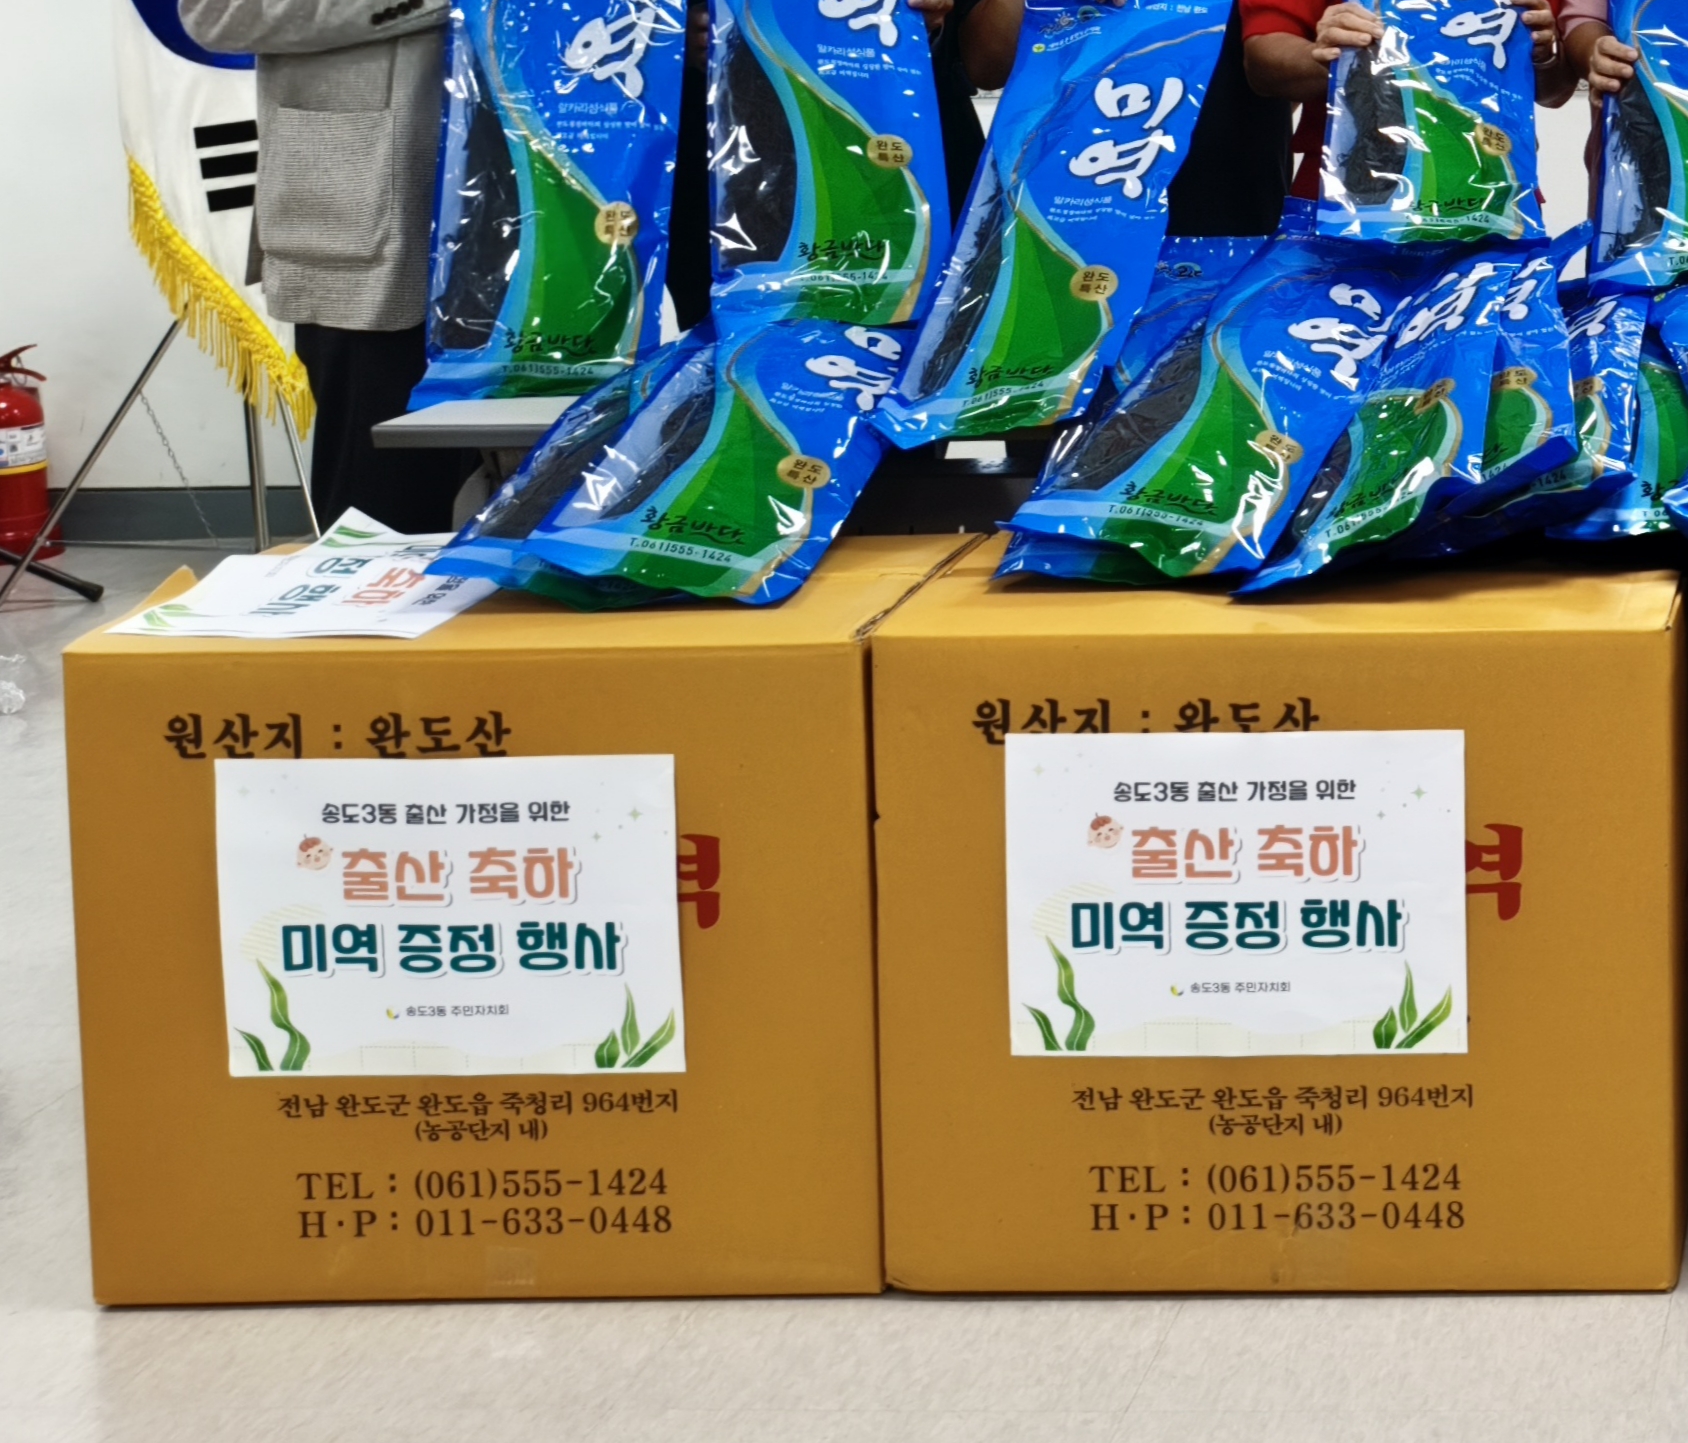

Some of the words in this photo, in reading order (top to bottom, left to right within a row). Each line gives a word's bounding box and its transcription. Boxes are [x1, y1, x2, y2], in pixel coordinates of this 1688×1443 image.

[1069, 77, 1183, 198] 미역
[164, 712, 302, 758] 원산지
[366, 710, 511, 758] 완도산
[1114, 782, 1189, 802] 송도3동
[1198, 781, 1238, 802] 출산
[1247, 780, 1307, 801] 가정을
[1316, 779, 1356, 800] 위한
[322, 803, 397, 824] 송도3동
[405, 804, 446, 824] 출산
[456, 802, 519, 823] 가정을
[528, 801, 570, 822] 위한
[1131, 827, 1234, 879] 출산
[1256, 825, 1358, 877] 축하
[342, 850, 443, 902] 출산
[469, 847, 573, 900] 축하
[1072, 902, 1164, 950] 미역
[1184, 901, 1282, 950] 증정
[1300, 899, 1402, 949] 행사
[281, 923, 377, 972] 미역
[398, 923, 496, 971] 증정
[517, 921, 620, 971] 행사
[1191, 982, 1230, 993] 송도3동
[1235, 982, 1290, 993] 주민자치회
[406, 1006, 446, 1017] 송도3동
[451, 1004, 509, 1016] 주민자치회
[277, 1094, 329, 1118] 전남
[335, 1094, 411, 1117] 완도군
[416, 1092, 494, 1120] 완도읍
[499, 1091, 572, 1120] 죽청리
[582, 1088, 677, 1113] 964번지
[1071, 1087, 1123, 1111] 전남
[1128, 1087, 1206, 1110] 완도군
[1211, 1086, 1288, 1110] 완도읍
[1294, 1085, 1367, 1110] 죽청리
[1378, 1083, 1472, 1108] 964번지
[415, 1118, 509, 1141] (농공단지
[518, 1118, 547, 1141] 내)
[1209, 1113, 1303, 1136] (농공단지
[1312, 1113, 1342, 1135] 내)
[415, 1167, 667, 1200] (061)555-1424
[1208, 1163, 1461, 1194] (061)555-1424
[416, 1205, 671, 1236] 011-633-0448
[1208, 1201, 1464, 1230] 011-633-0448
